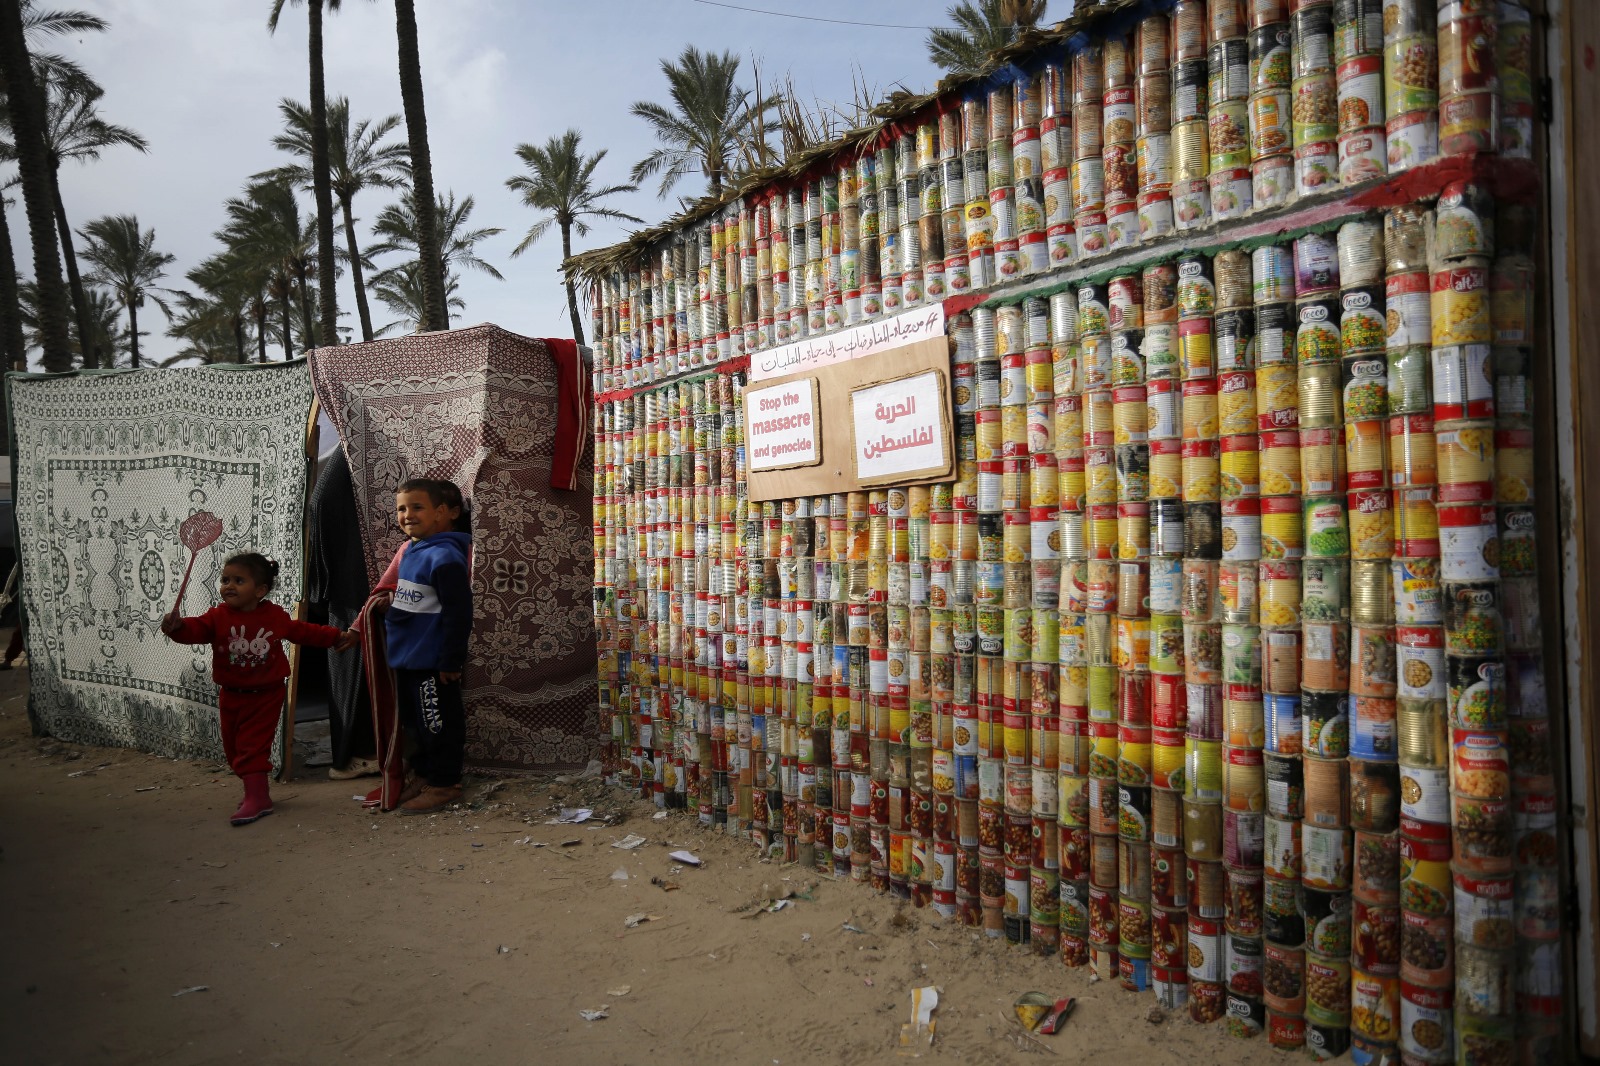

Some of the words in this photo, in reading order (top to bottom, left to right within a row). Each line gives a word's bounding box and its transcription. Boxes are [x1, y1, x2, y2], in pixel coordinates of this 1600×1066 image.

[760, 398, 781, 411] Stop
[783, 392, 800, 406] the
[875, 396, 916, 424] الحرية
[753, 413, 811, 435] massacre
[754, 444, 770, 458] and
[771, 438, 812, 458] genocide
[863, 425, 934, 459] لفلسطين
